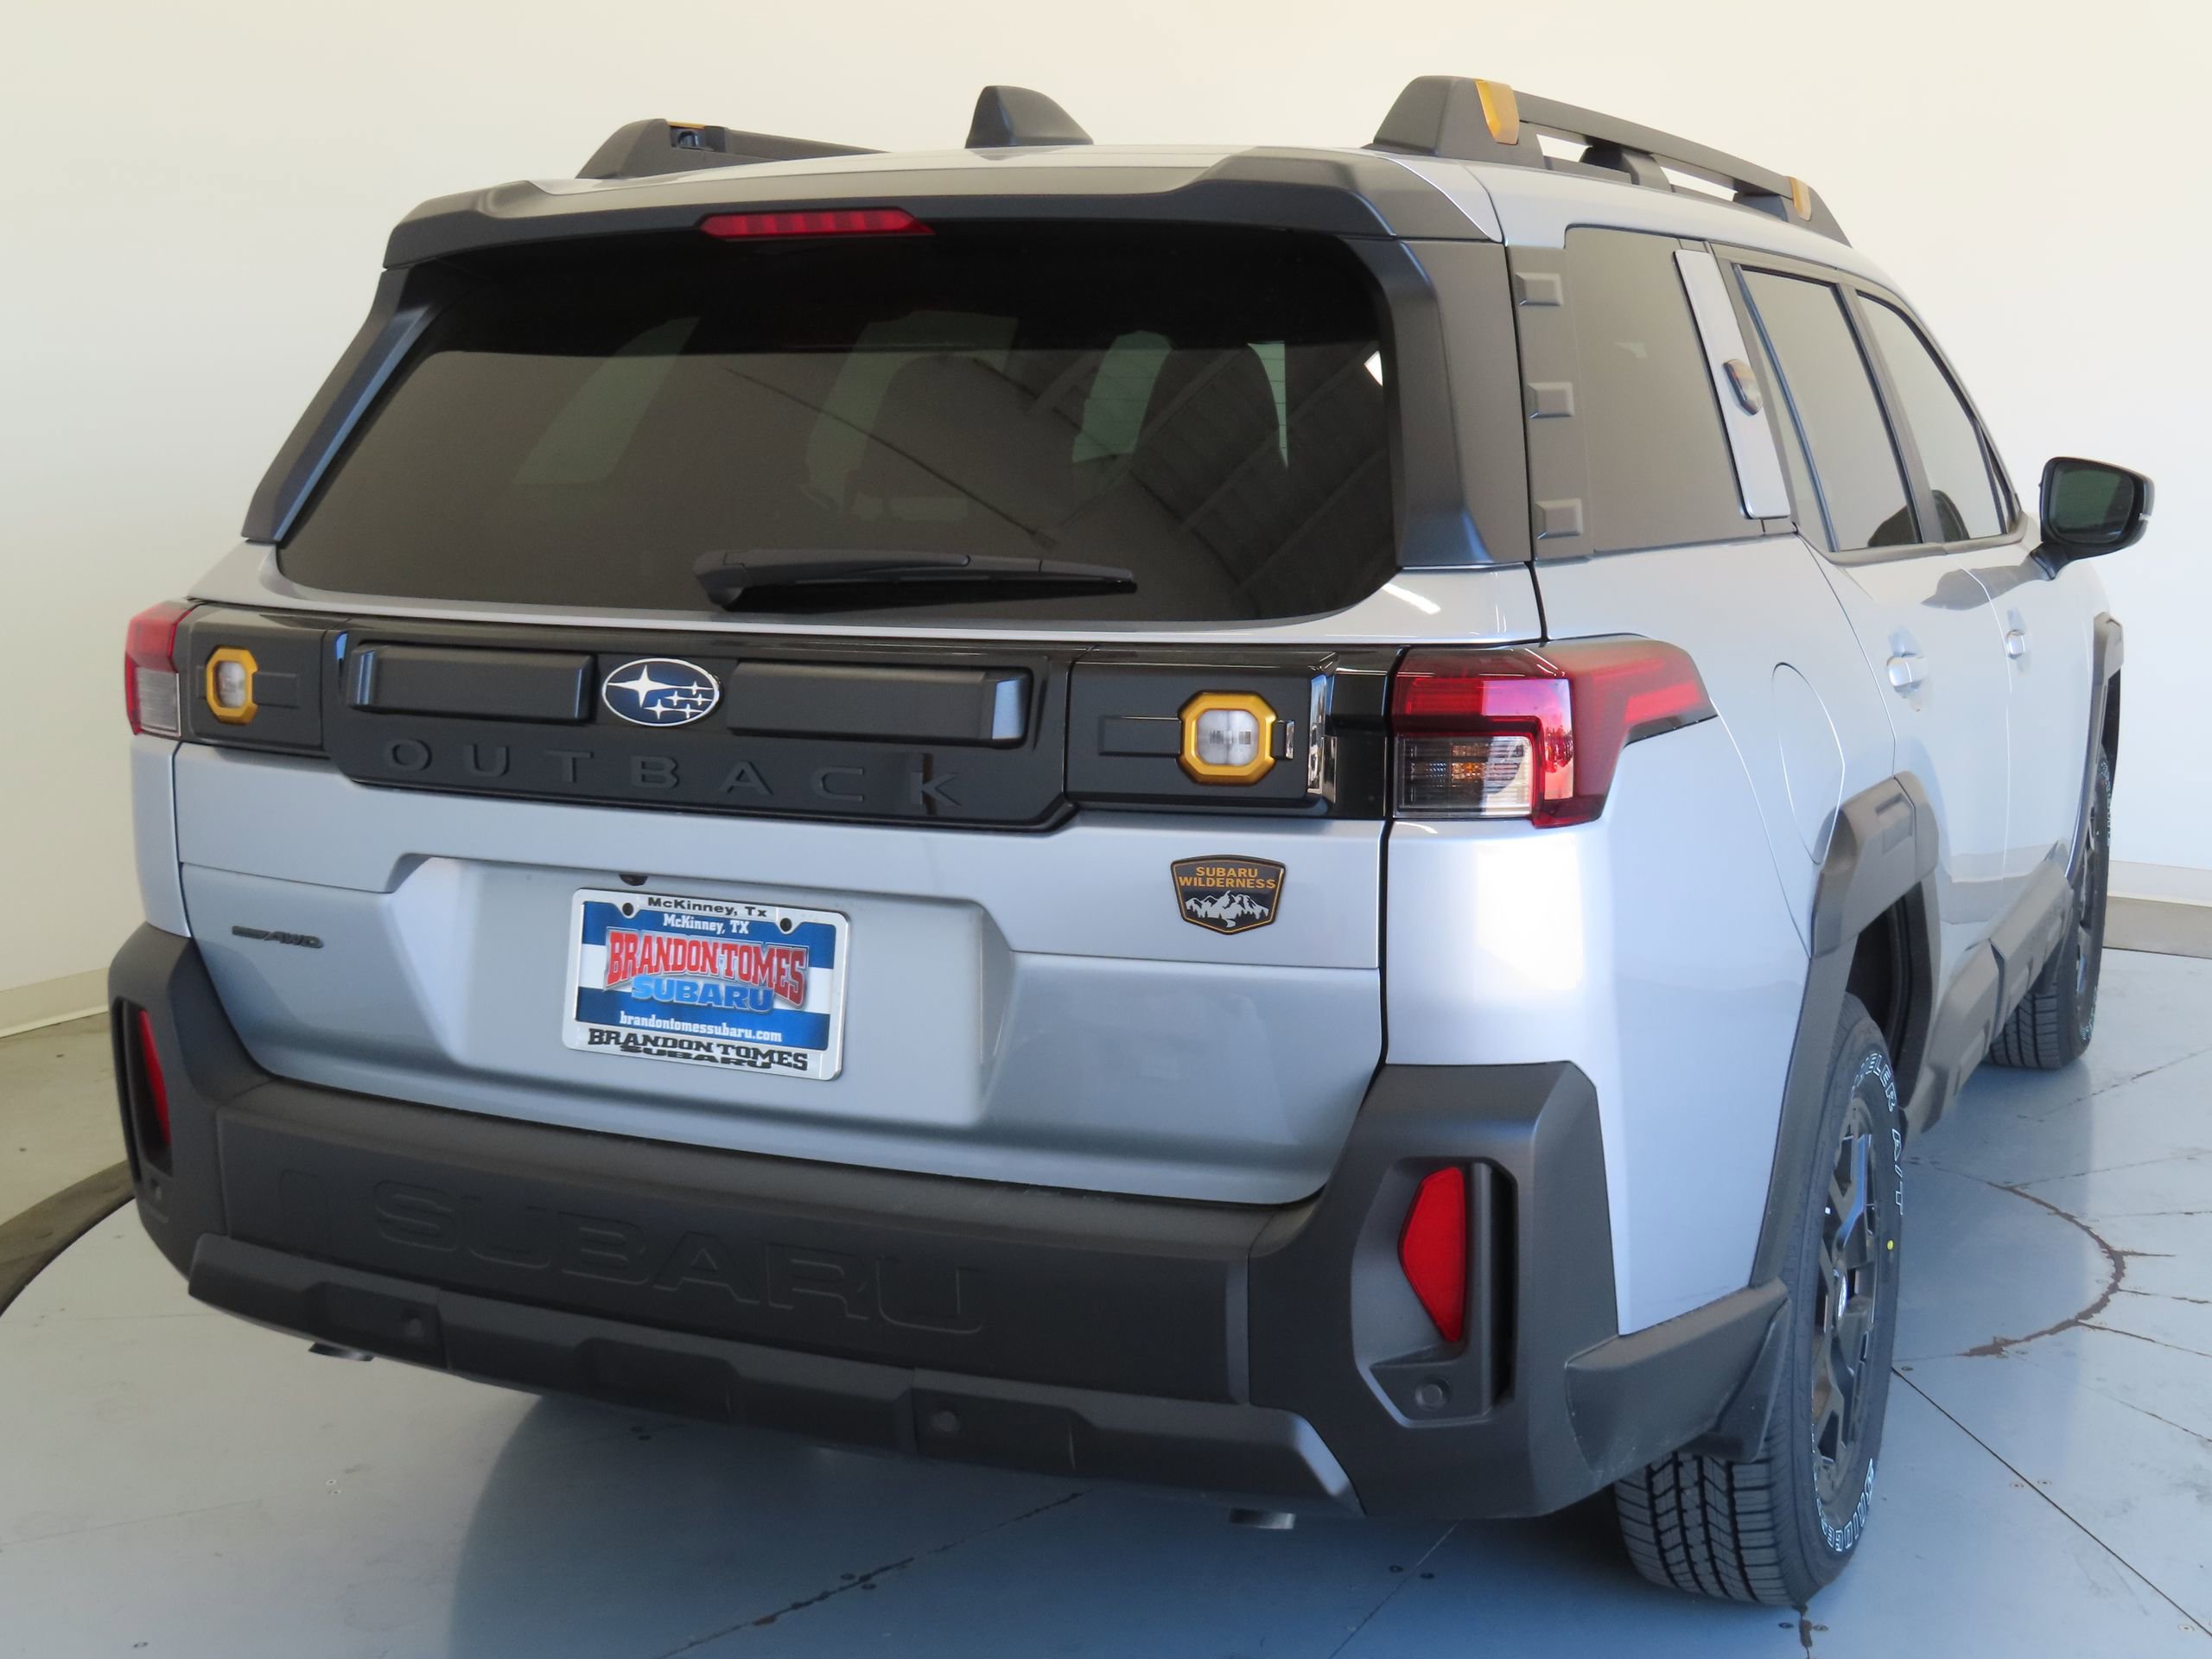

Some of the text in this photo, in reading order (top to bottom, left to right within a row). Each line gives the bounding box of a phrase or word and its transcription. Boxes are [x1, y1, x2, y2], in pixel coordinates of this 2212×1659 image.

[384, 738, 961, 807] OUTBACK
[1178, 876, 1276, 889] WILDERNESS
[1195, 866, 1258, 878] SUBARU
[647, 896, 767, 918] McKinney, Tx
[663, 912, 750, 935] McKinney, TX
[607, 930, 807, 1007] BRANDON TOMES
[631, 974, 775, 1014] SUBARU
[619, 1010, 783, 1043] brandontomessubaru.com
[588, 1027, 809, 1071] BRANDON TOMES
[620, 1045, 772, 1070] SUBARU
[372, 1179, 986, 1336] SUBARU
